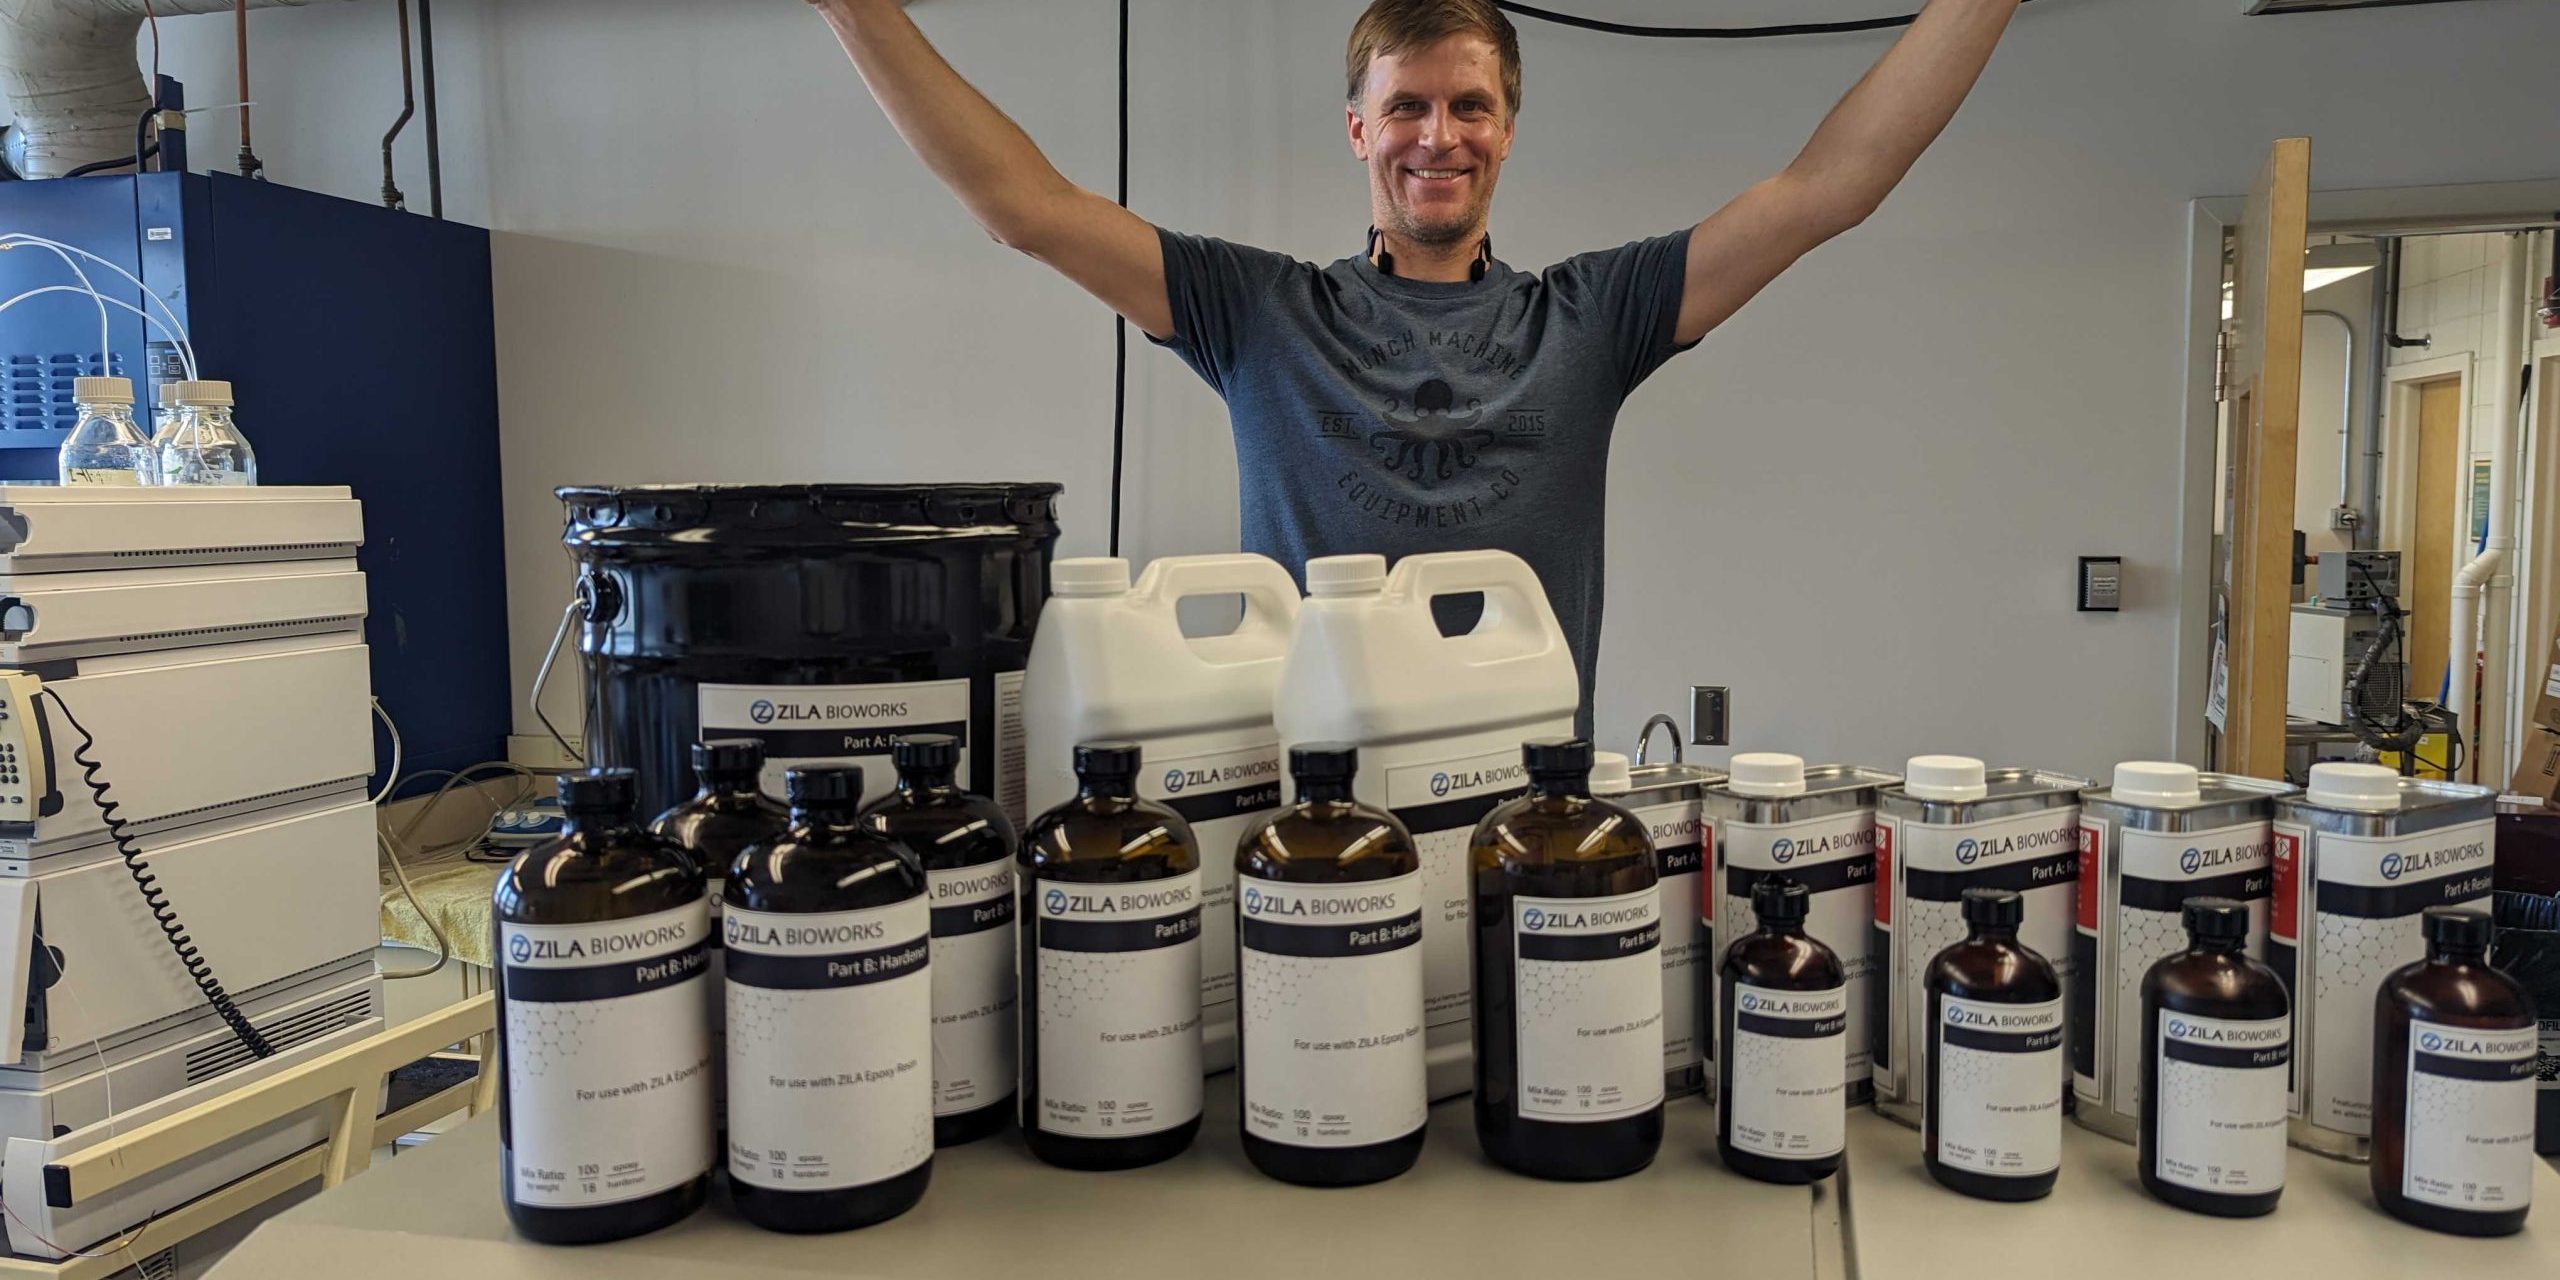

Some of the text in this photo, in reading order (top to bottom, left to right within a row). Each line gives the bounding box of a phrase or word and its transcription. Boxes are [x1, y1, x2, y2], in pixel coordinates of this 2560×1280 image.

[1341, 329, 1527, 381] MUNCH MACHINE
[1508, 415, 1545, 432] 2015
[1337, 471, 1482, 528] EQUIPMENT
[777, 703, 908, 720] ZILA BIOWORKS
[844, 736, 870, 749] Part
[1187, 759, 1279, 786] ZILA BIOWORKS
[1451, 771, 1483, 789] ZILA
[1236, 794, 1255, 807] Part
[1796, 837, 1830, 857] ZILA
[1980, 837, 2014, 858] ZILA
[1667, 856, 1688, 868] Part
[2202, 848, 2232, 867] ZILA
[2404, 842, 2484, 873] ZILA BIOWORKS
[1848, 865, 1868, 878] Part
[2032, 867, 2053, 880] Part
[939, 871, 1009, 898] BIOWORKS
[2245, 878, 2263, 892] Part
[2444, 883, 2462, 897] Part
[1070, 886, 1192, 912] ZILA BIOWORKS
[1264, 893, 1395, 916] ZILA BIOWORKS
[974, 908, 996, 924] Part
[1547, 904, 1648, 928] ZILA BIOWORKS
[741, 921, 884, 945] ZILA BIOWORKS
[1155, 922, 1178, 938] Part
[1350, 927, 1391, 946] Part B:
[534, 922, 686, 959] ZILA BIOWORKS
[1619, 936, 1638, 950] Part
[827, 946, 927, 978] Part B: Hardener
[636, 960, 682, 984] Part B:
[1759, 999, 1839, 1013] ZILA BIOWORKS
[960, 1009, 979, 1021] with
[1966, 1012, 2053, 1026] ZILA BIOWORKS
[1100, 1024, 1179, 1042] For use with ZILA
[1577, 1028, 1591, 1037] For
[1609, 1025, 1625, 1035] with
[1815, 1022, 1829, 1032] Part
[2189, 1026, 2281, 1041] ZILA BIOWORKS
[1294, 1038, 1310, 1050] For
[1313, 1040, 1330, 1050] use
[1333, 1039, 1356, 1050] with
[1358, 1035, 1379, 1049] ZILA
[2026, 1036, 2042, 1048] Part
[2444, 1039, 2482, 1054] ZILA
[2253, 1052, 2270, 1063] Part
[576, 1089, 595, 1101] For
[600, 1088, 620, 1099] use
[622, 1082, 648, 1095] with
[651, 1073, 673, 1088] ZILA
[769, 1076, 785, 1088] For
[788, 1078, 806, 1088] use
[810, 1077, 835, 1087] with
[838, 1072, 863, 1085] ZILA
[865, 1071, 895, 1082] Epoxy
[1528, 1086, 1568, 1096] Mix Ratio:
[1577, 1085, 1591, 1094] 100
[1776, 1087, 1786, 1095] For
[1098, 1100, 1116, 1110] 100
[1100, 1117, 1113, 1126] 18
[1293, 1109, 1311, 1120] 100
[1297, 1127, 1309, 1137] 18
[2466, 1135, 2478, 1143] For
[768, 1150, 787, 1161] 100
[578, 1164, 599, 1175] 100
[583, 1184, 596, 1193] 18
